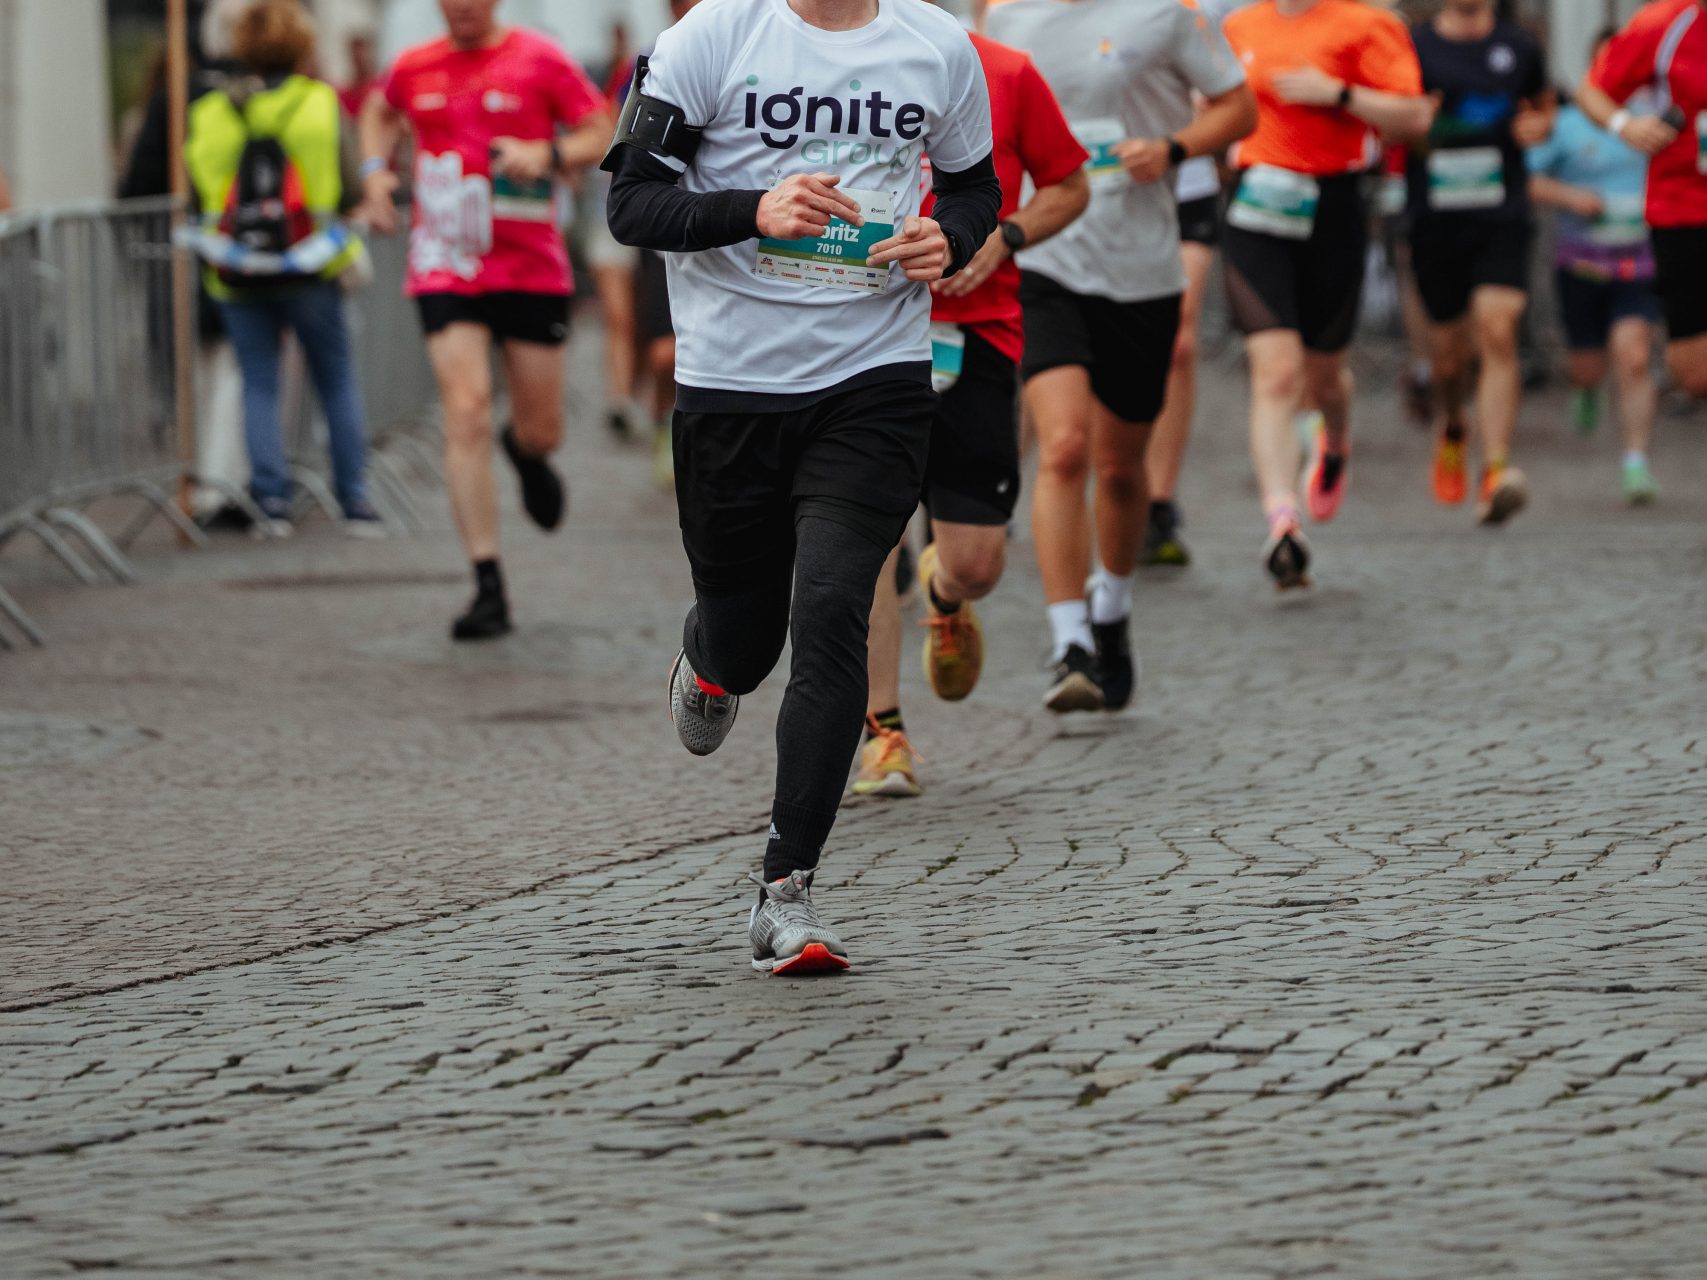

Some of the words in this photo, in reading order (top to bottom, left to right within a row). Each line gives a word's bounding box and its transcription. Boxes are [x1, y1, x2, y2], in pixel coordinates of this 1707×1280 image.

[745, 74, 925, 150] ignite
[801, 138, 912, 173] Group
[820, 223, 860, 243] oritz
[816, 242, 843, 255] 7010
